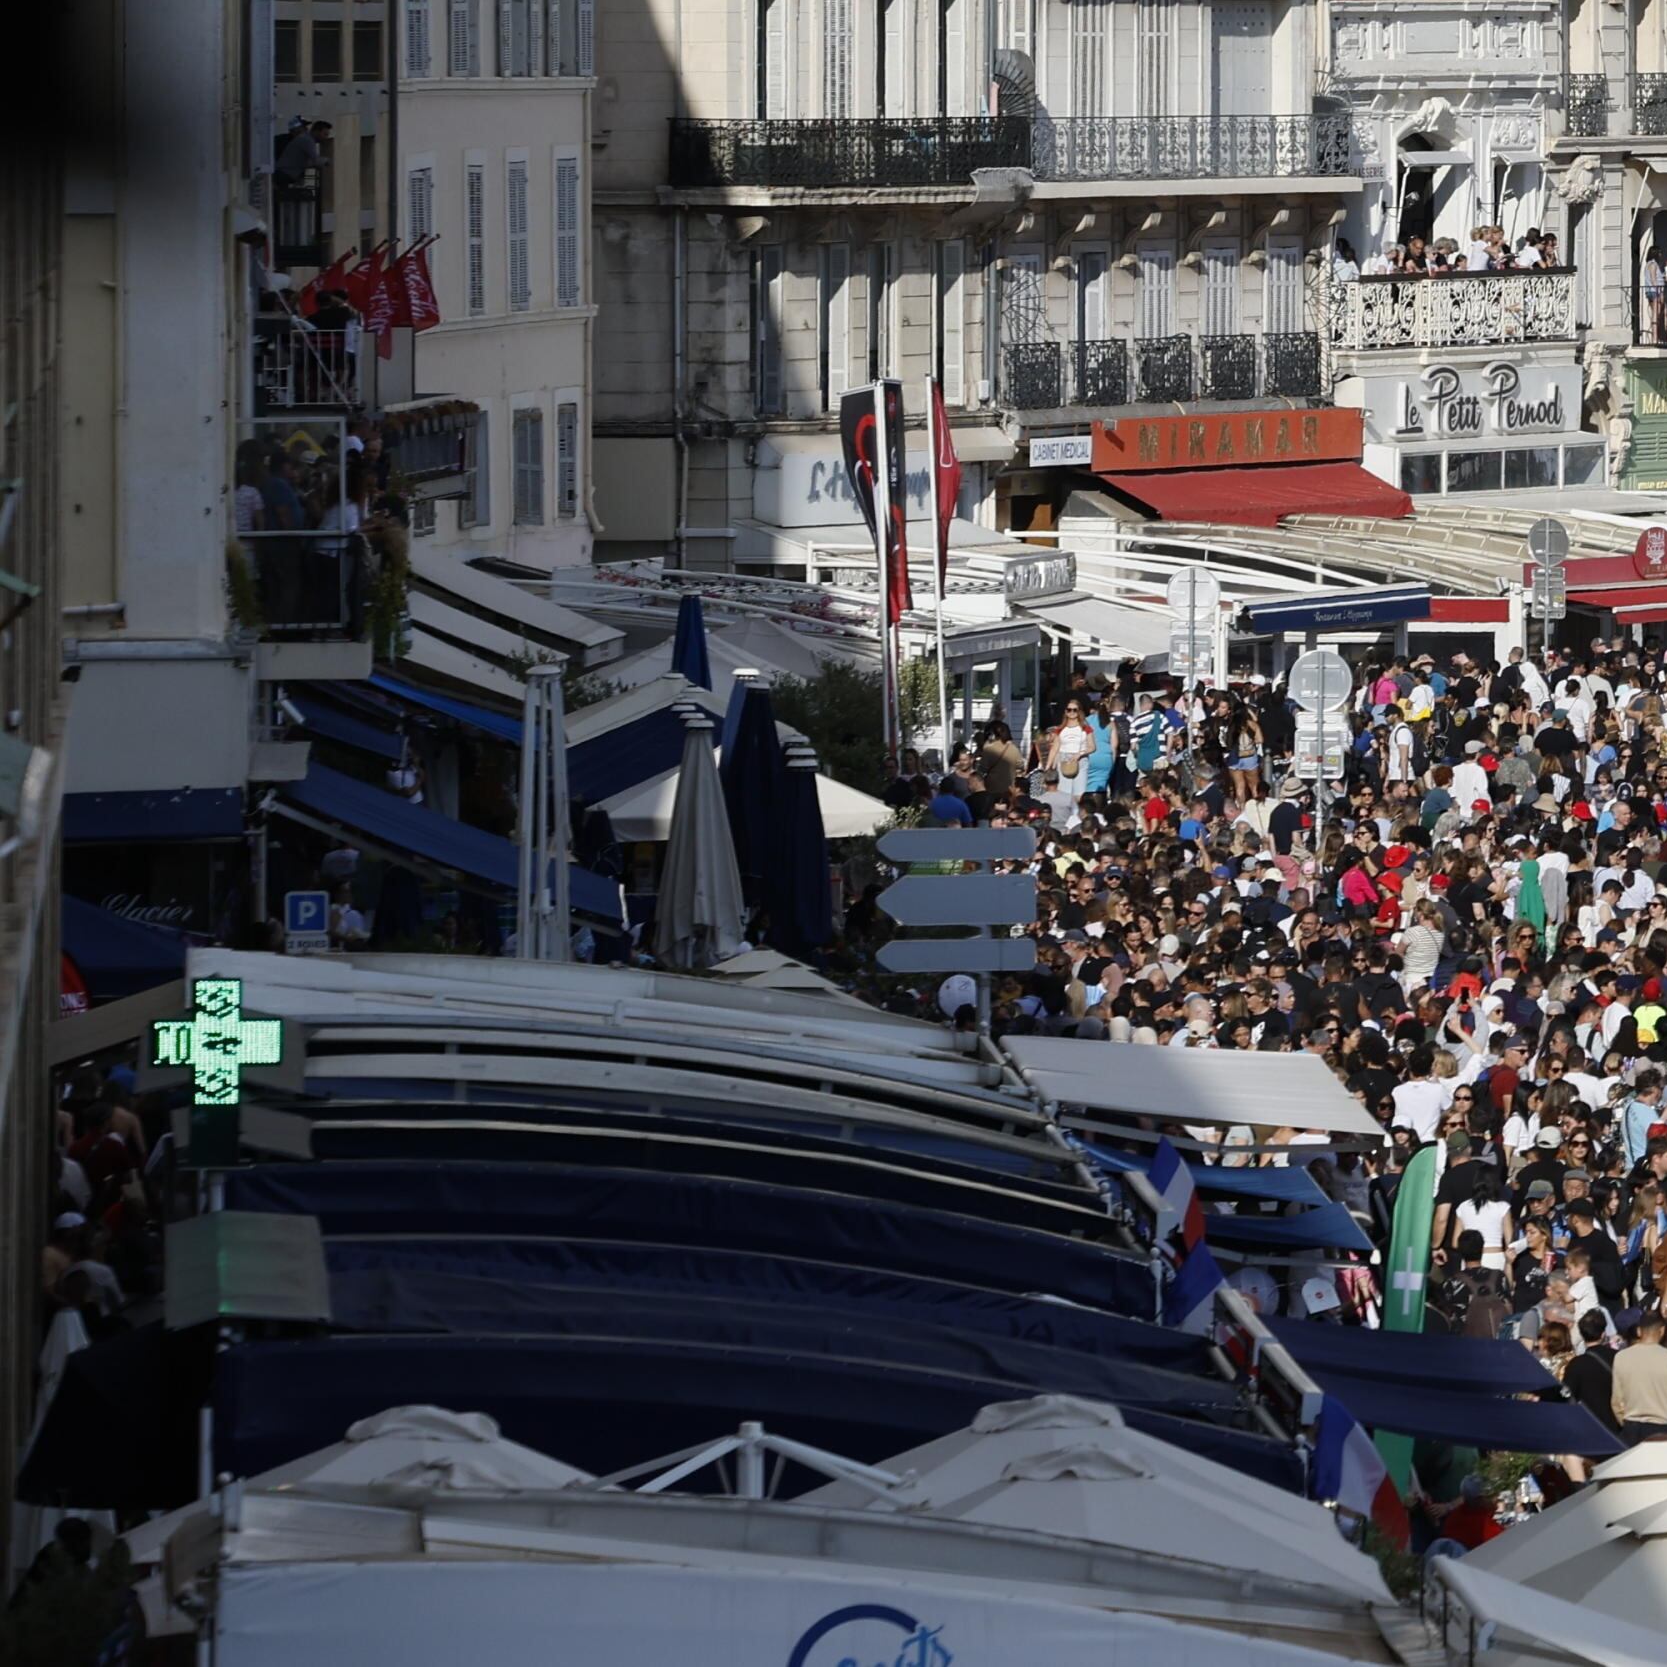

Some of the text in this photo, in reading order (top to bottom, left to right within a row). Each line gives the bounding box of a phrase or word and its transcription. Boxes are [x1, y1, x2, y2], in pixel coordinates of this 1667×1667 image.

[1396, 363, 1562, 435] Le Petit Pernod
[1033, 442, 1060, 461] CABINET
[1138, 415, 1321, 463] MIRAMAR
[297, 900, 318, 926] P
